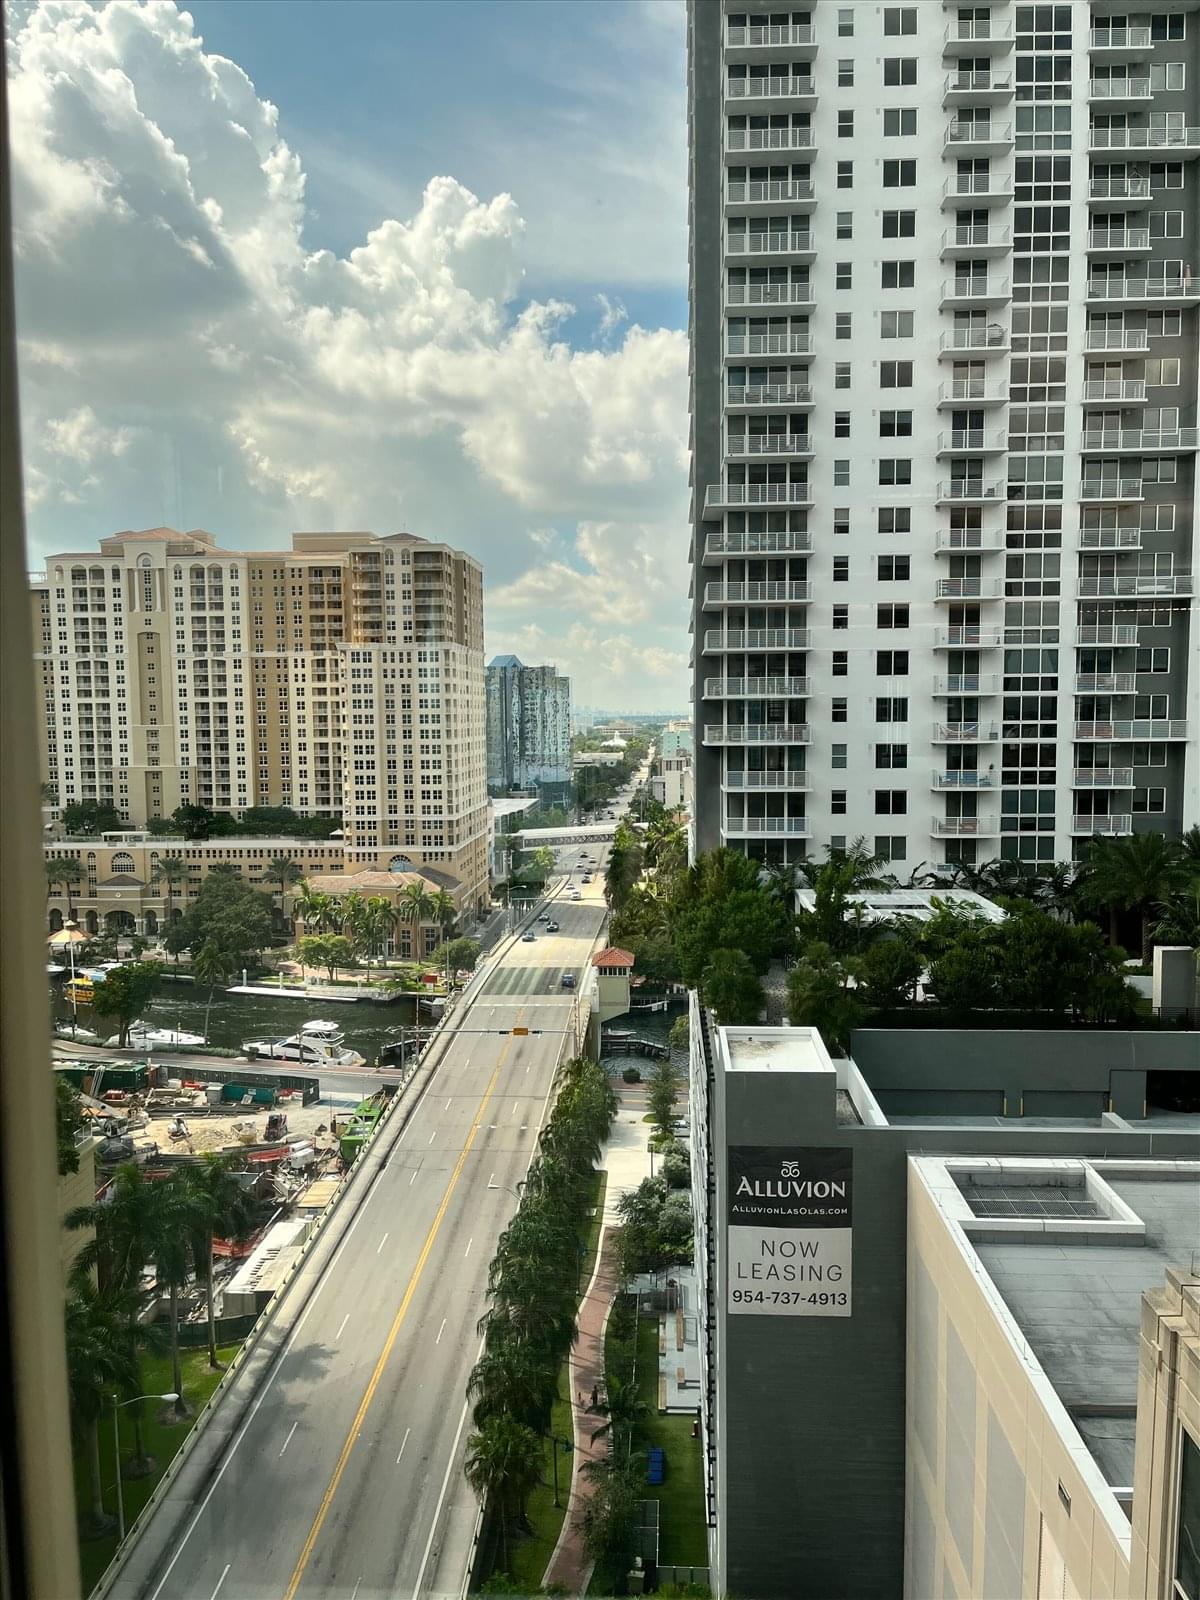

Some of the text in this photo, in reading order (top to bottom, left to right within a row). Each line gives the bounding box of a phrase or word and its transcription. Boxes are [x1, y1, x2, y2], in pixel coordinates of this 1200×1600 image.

[736, 1176, 846, 1198] ALLUVION
[732, 1205, 848, 1215] ALLUVIONLASOLAS.COM
[761, 1240, 819, 1258] NOW
[737, 1262, 843, 1282] LEASING
[732, 1290, 847, 1306] 954-737-4913
